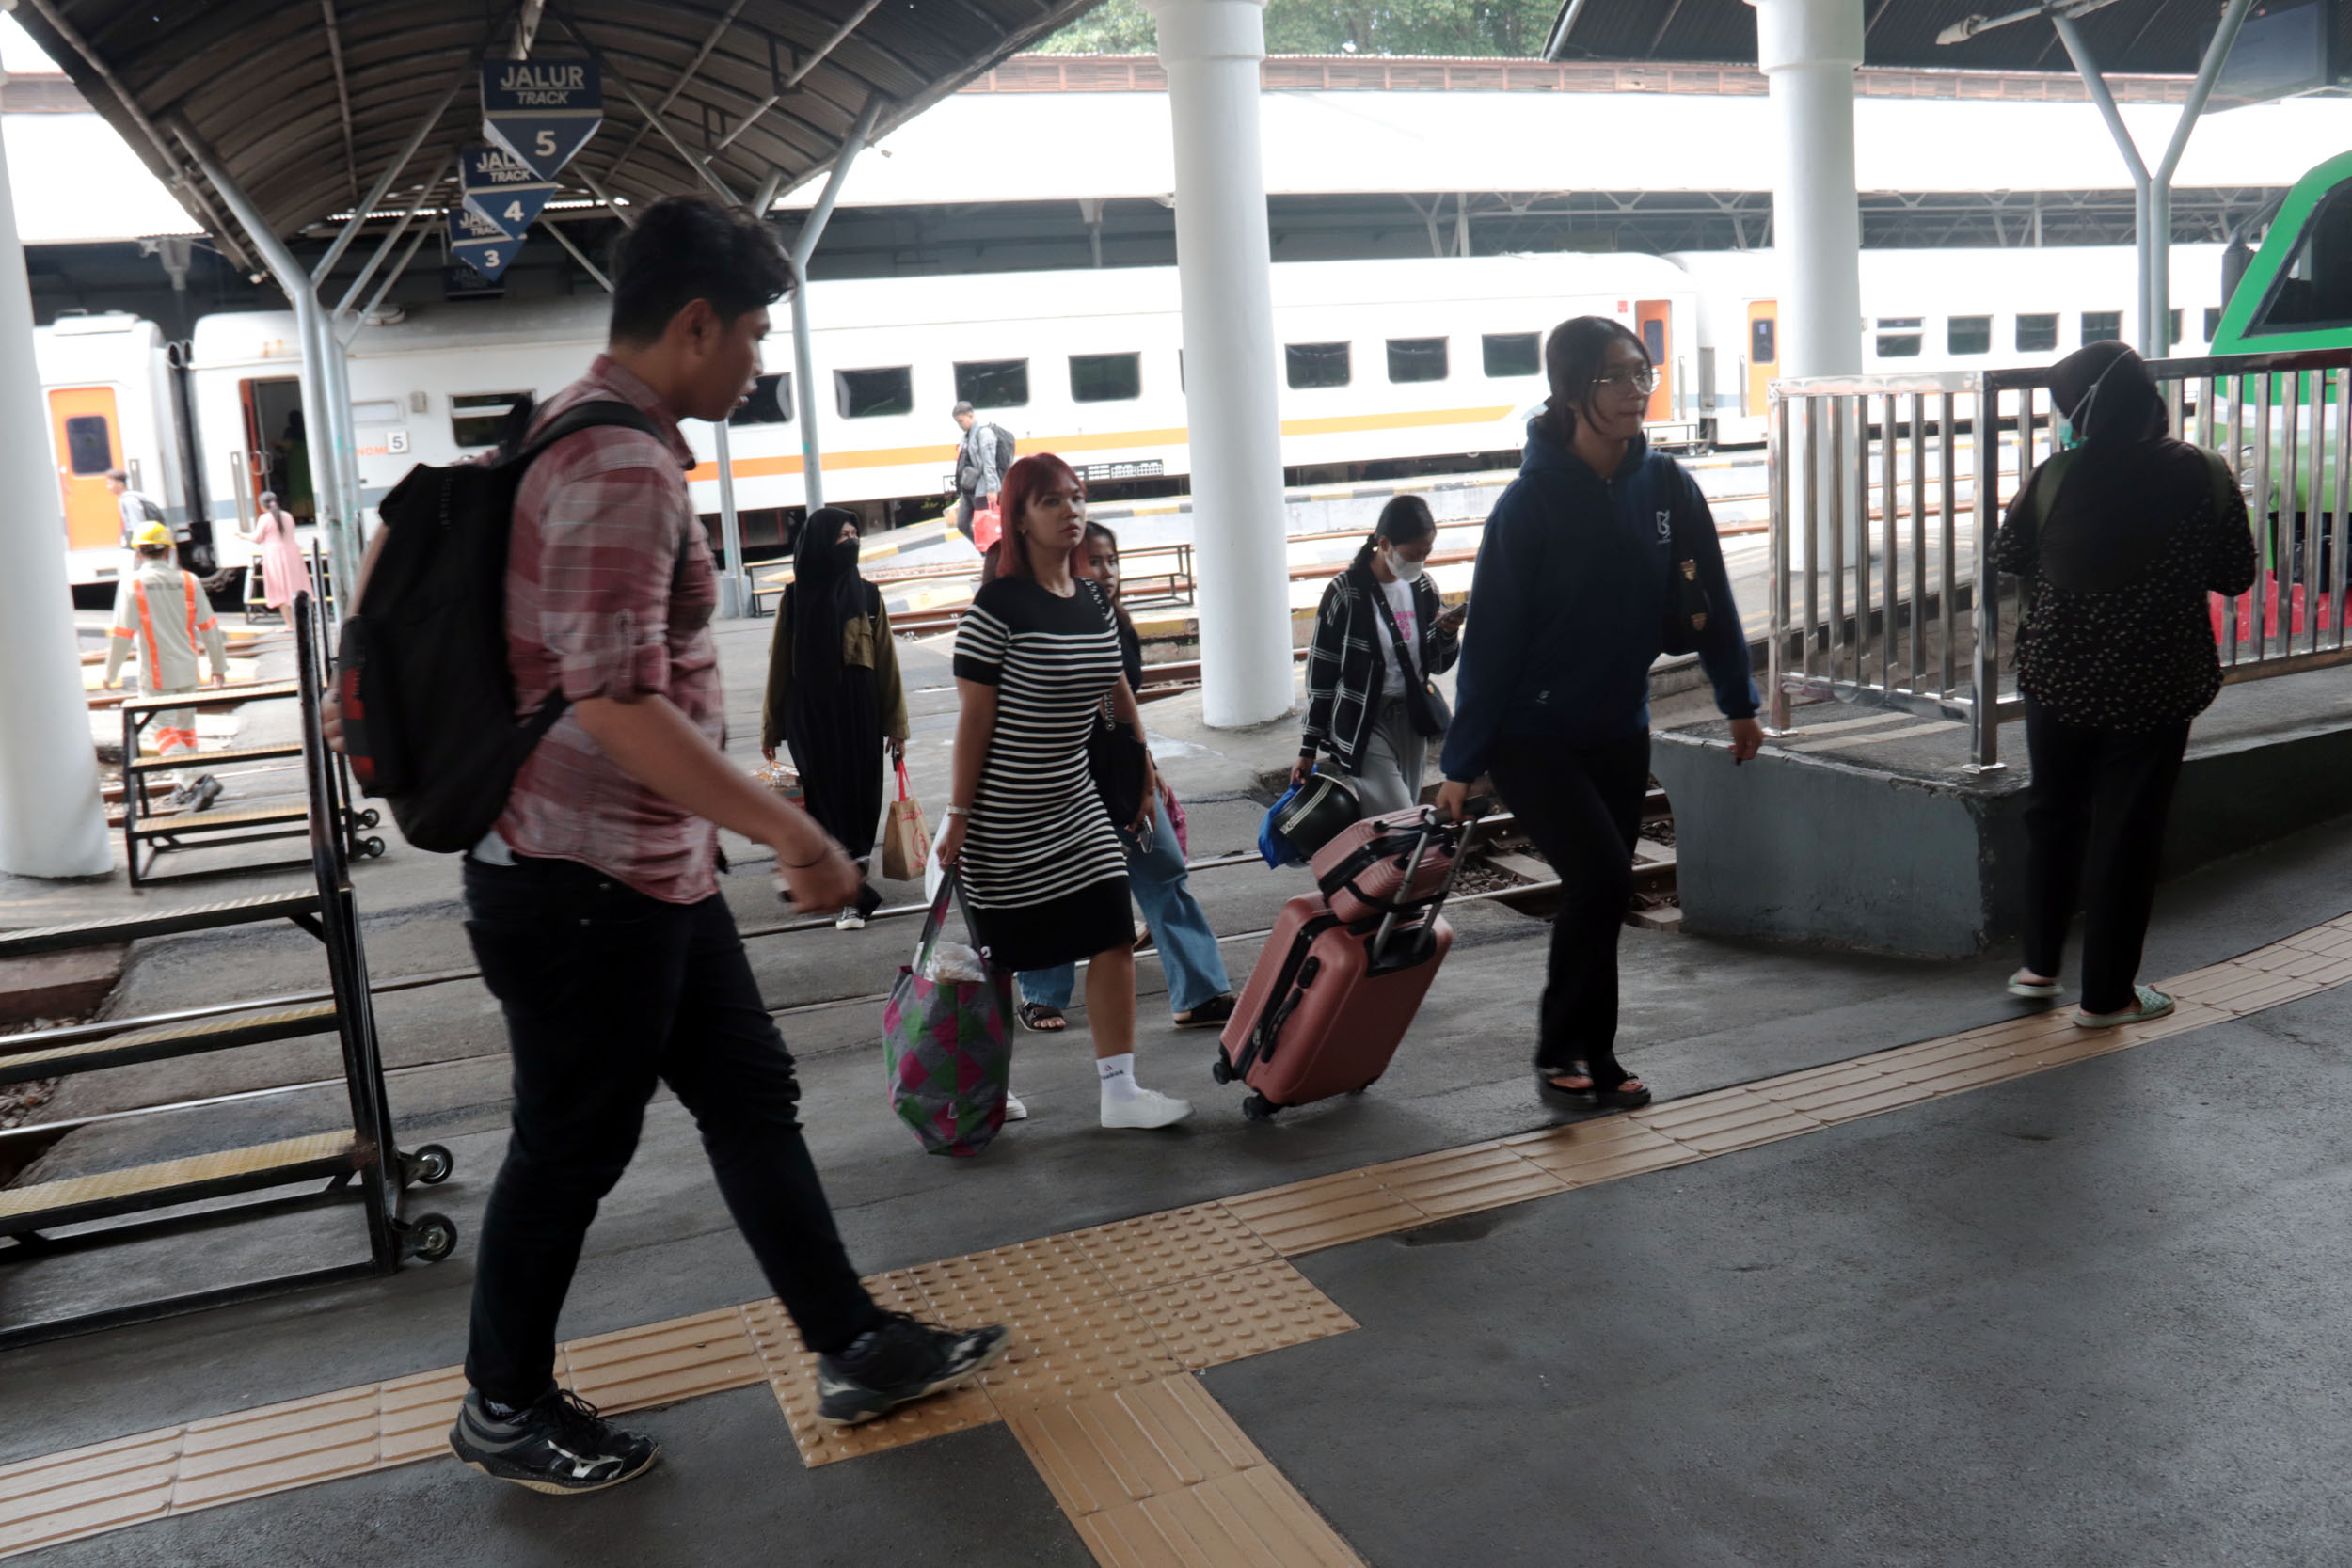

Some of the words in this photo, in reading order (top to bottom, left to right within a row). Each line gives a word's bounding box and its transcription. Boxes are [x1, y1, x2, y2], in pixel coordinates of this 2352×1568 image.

[501, 67, 583, 87] JALUR
[517, 92, 568, 104] TRACK
[535, 131, 556, 156] 5
[476, 152, 519, 169] JAL
[490, 170, 531, 182] TRACK
[503, 200, 525, 222] 4
[484, 249, 501, 268] 3
[392, 436, 404, 450] 5
